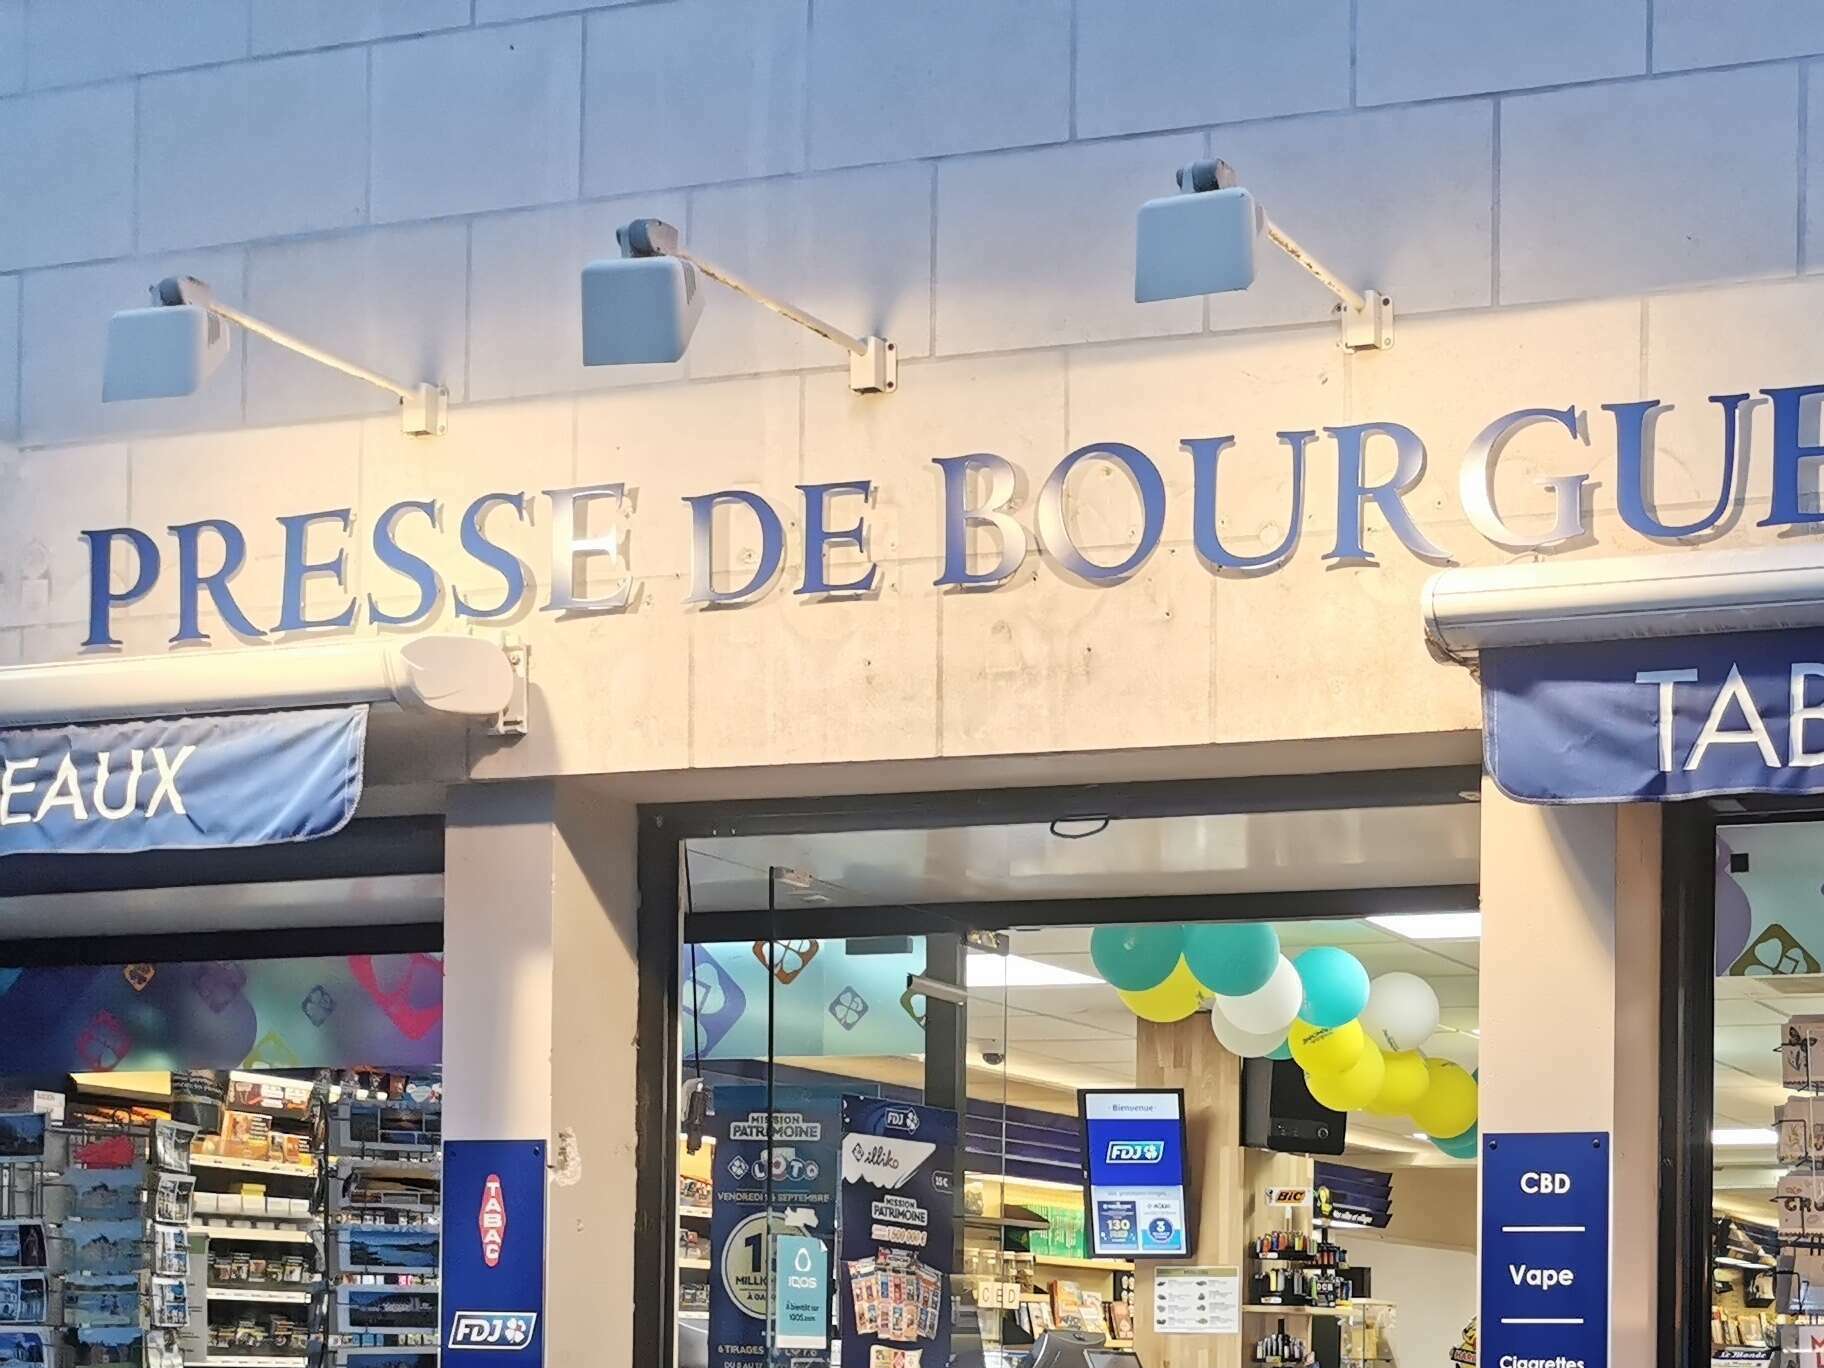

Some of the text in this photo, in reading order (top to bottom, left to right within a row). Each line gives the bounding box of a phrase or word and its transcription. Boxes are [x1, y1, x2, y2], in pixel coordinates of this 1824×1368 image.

[80, 481, 638, 648] PRESSE
[684, 480, 879, 605] DE
[0, 743, 197, 824] EAUX
[733, 1125, 819, 1138] PATRMOINE
[1111, 1145, 1142, 1160] FDJ
[1521, 1173, 1570, 1193] CBD
[483, 1182, 503, 1260] TABAC
[788, 1277, 818, 1289] IQOS
[1510, 1265, 1573, 1290] Vape
[457, 1318, 503, 1343] FDJ
[1731, 1350, 1767, 1360] Monde
